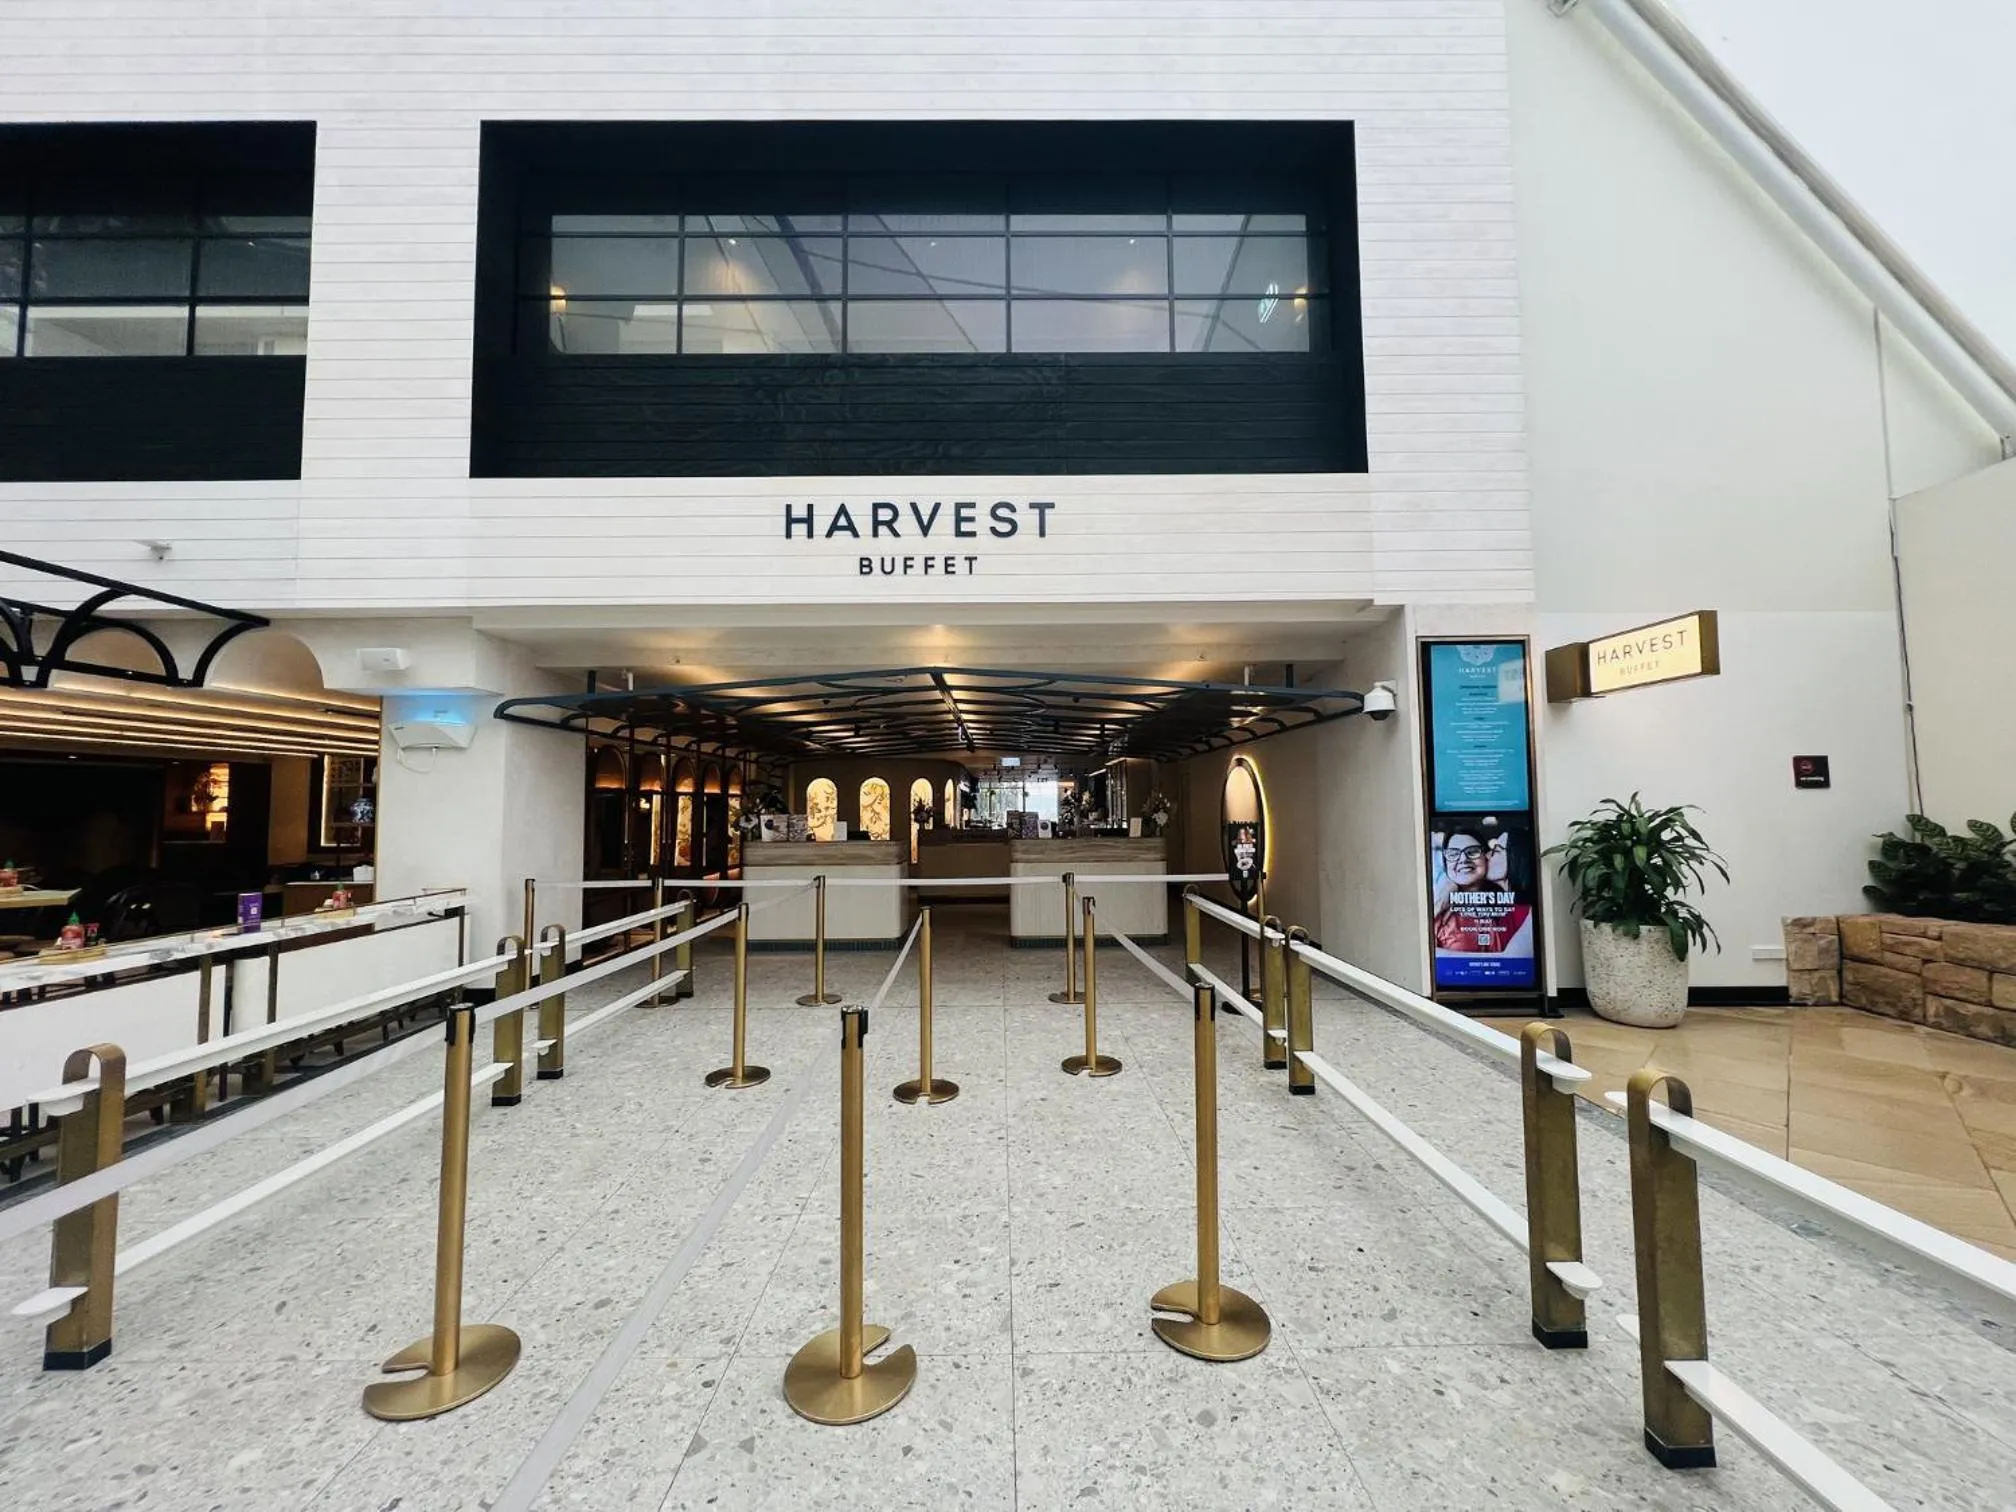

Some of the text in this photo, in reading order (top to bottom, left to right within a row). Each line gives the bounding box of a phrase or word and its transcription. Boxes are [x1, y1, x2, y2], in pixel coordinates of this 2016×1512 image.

[785, 501, 1056, 539] HARVEST
[859, 556, 978, 576] BUFFET
[1597, 629, 1687, 667] HARVEST
[1449, 891, 1515, 904] MOTHER'S DAY
